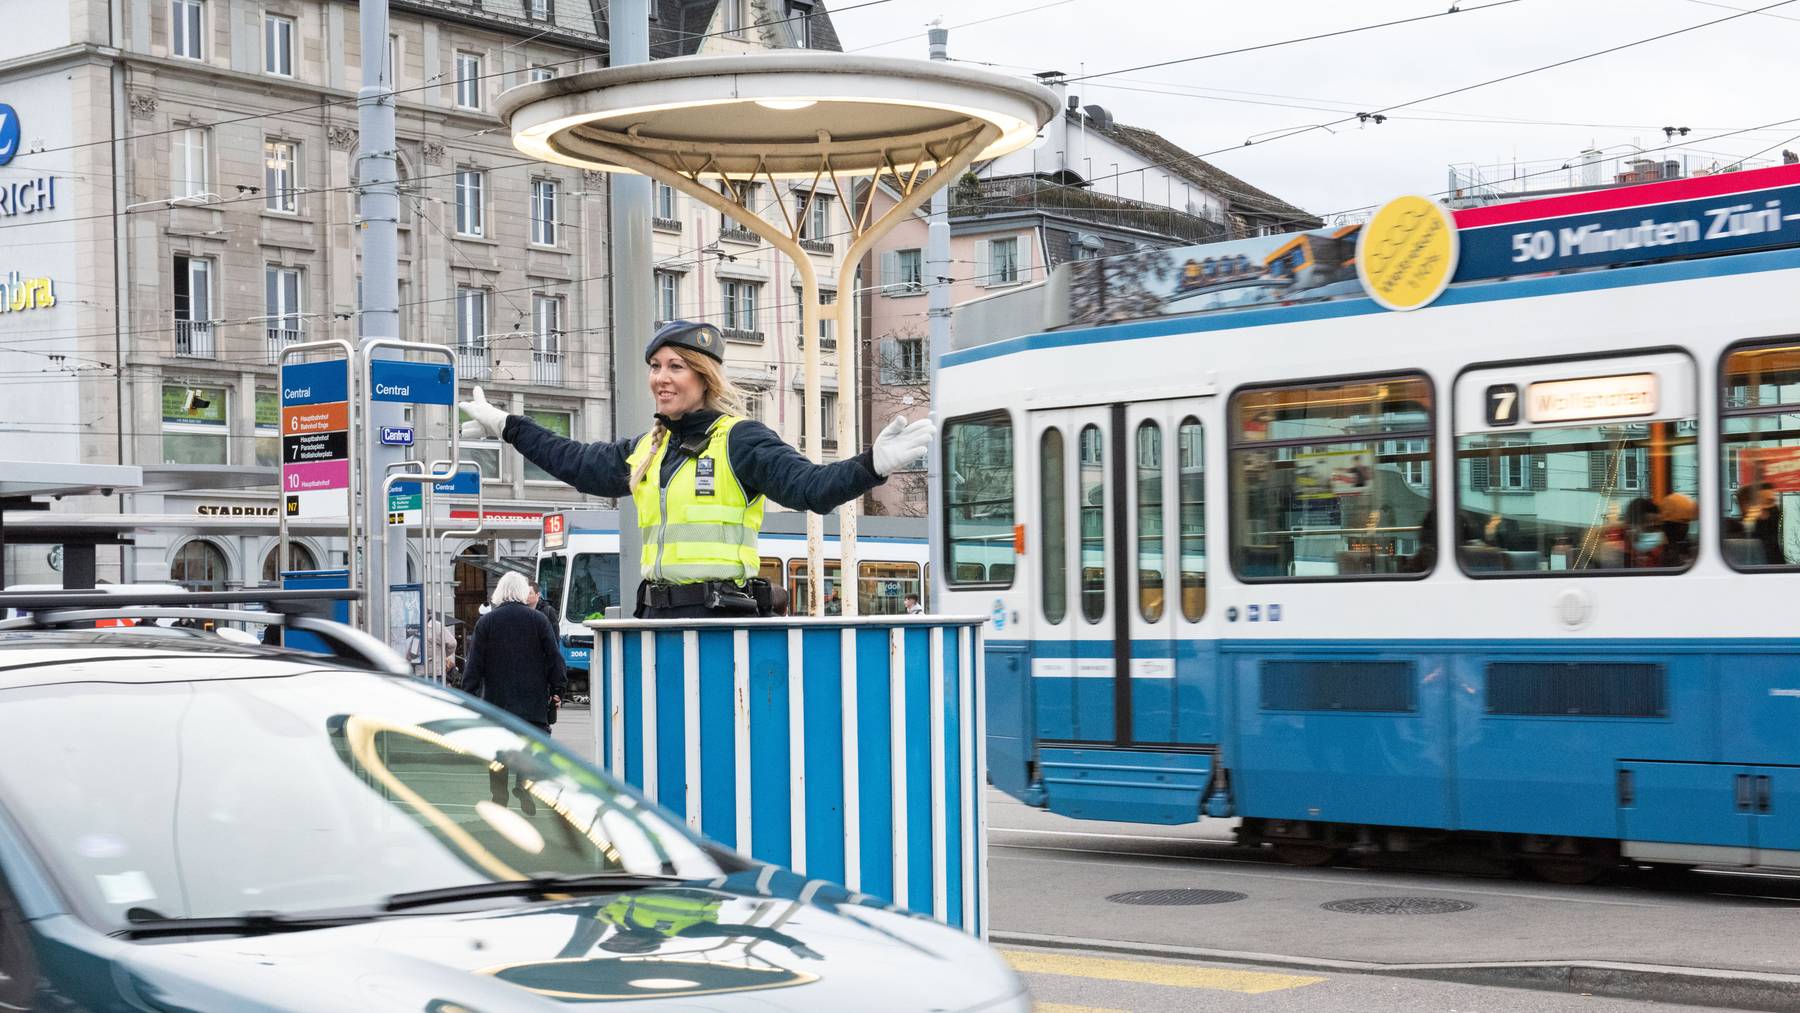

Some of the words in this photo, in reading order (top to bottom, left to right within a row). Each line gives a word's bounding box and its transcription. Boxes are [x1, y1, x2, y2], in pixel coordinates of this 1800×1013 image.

[1512, 229, 1555, 262] 50
[1559, 219, 1700, 257] Minuten
[284, 387, 311, 399] Central
[375, 383, 410, 396] Central
[1491, 391, 1517, 420] 7
[291, 416, 298, 431] 6
[384, 428, 411, 442] Central
[291, 445, 298, 459] 7
[288, 473, 300, 488] 10
[288, 502, 297, 512] N7
[549, 516, 560, 533] 15
